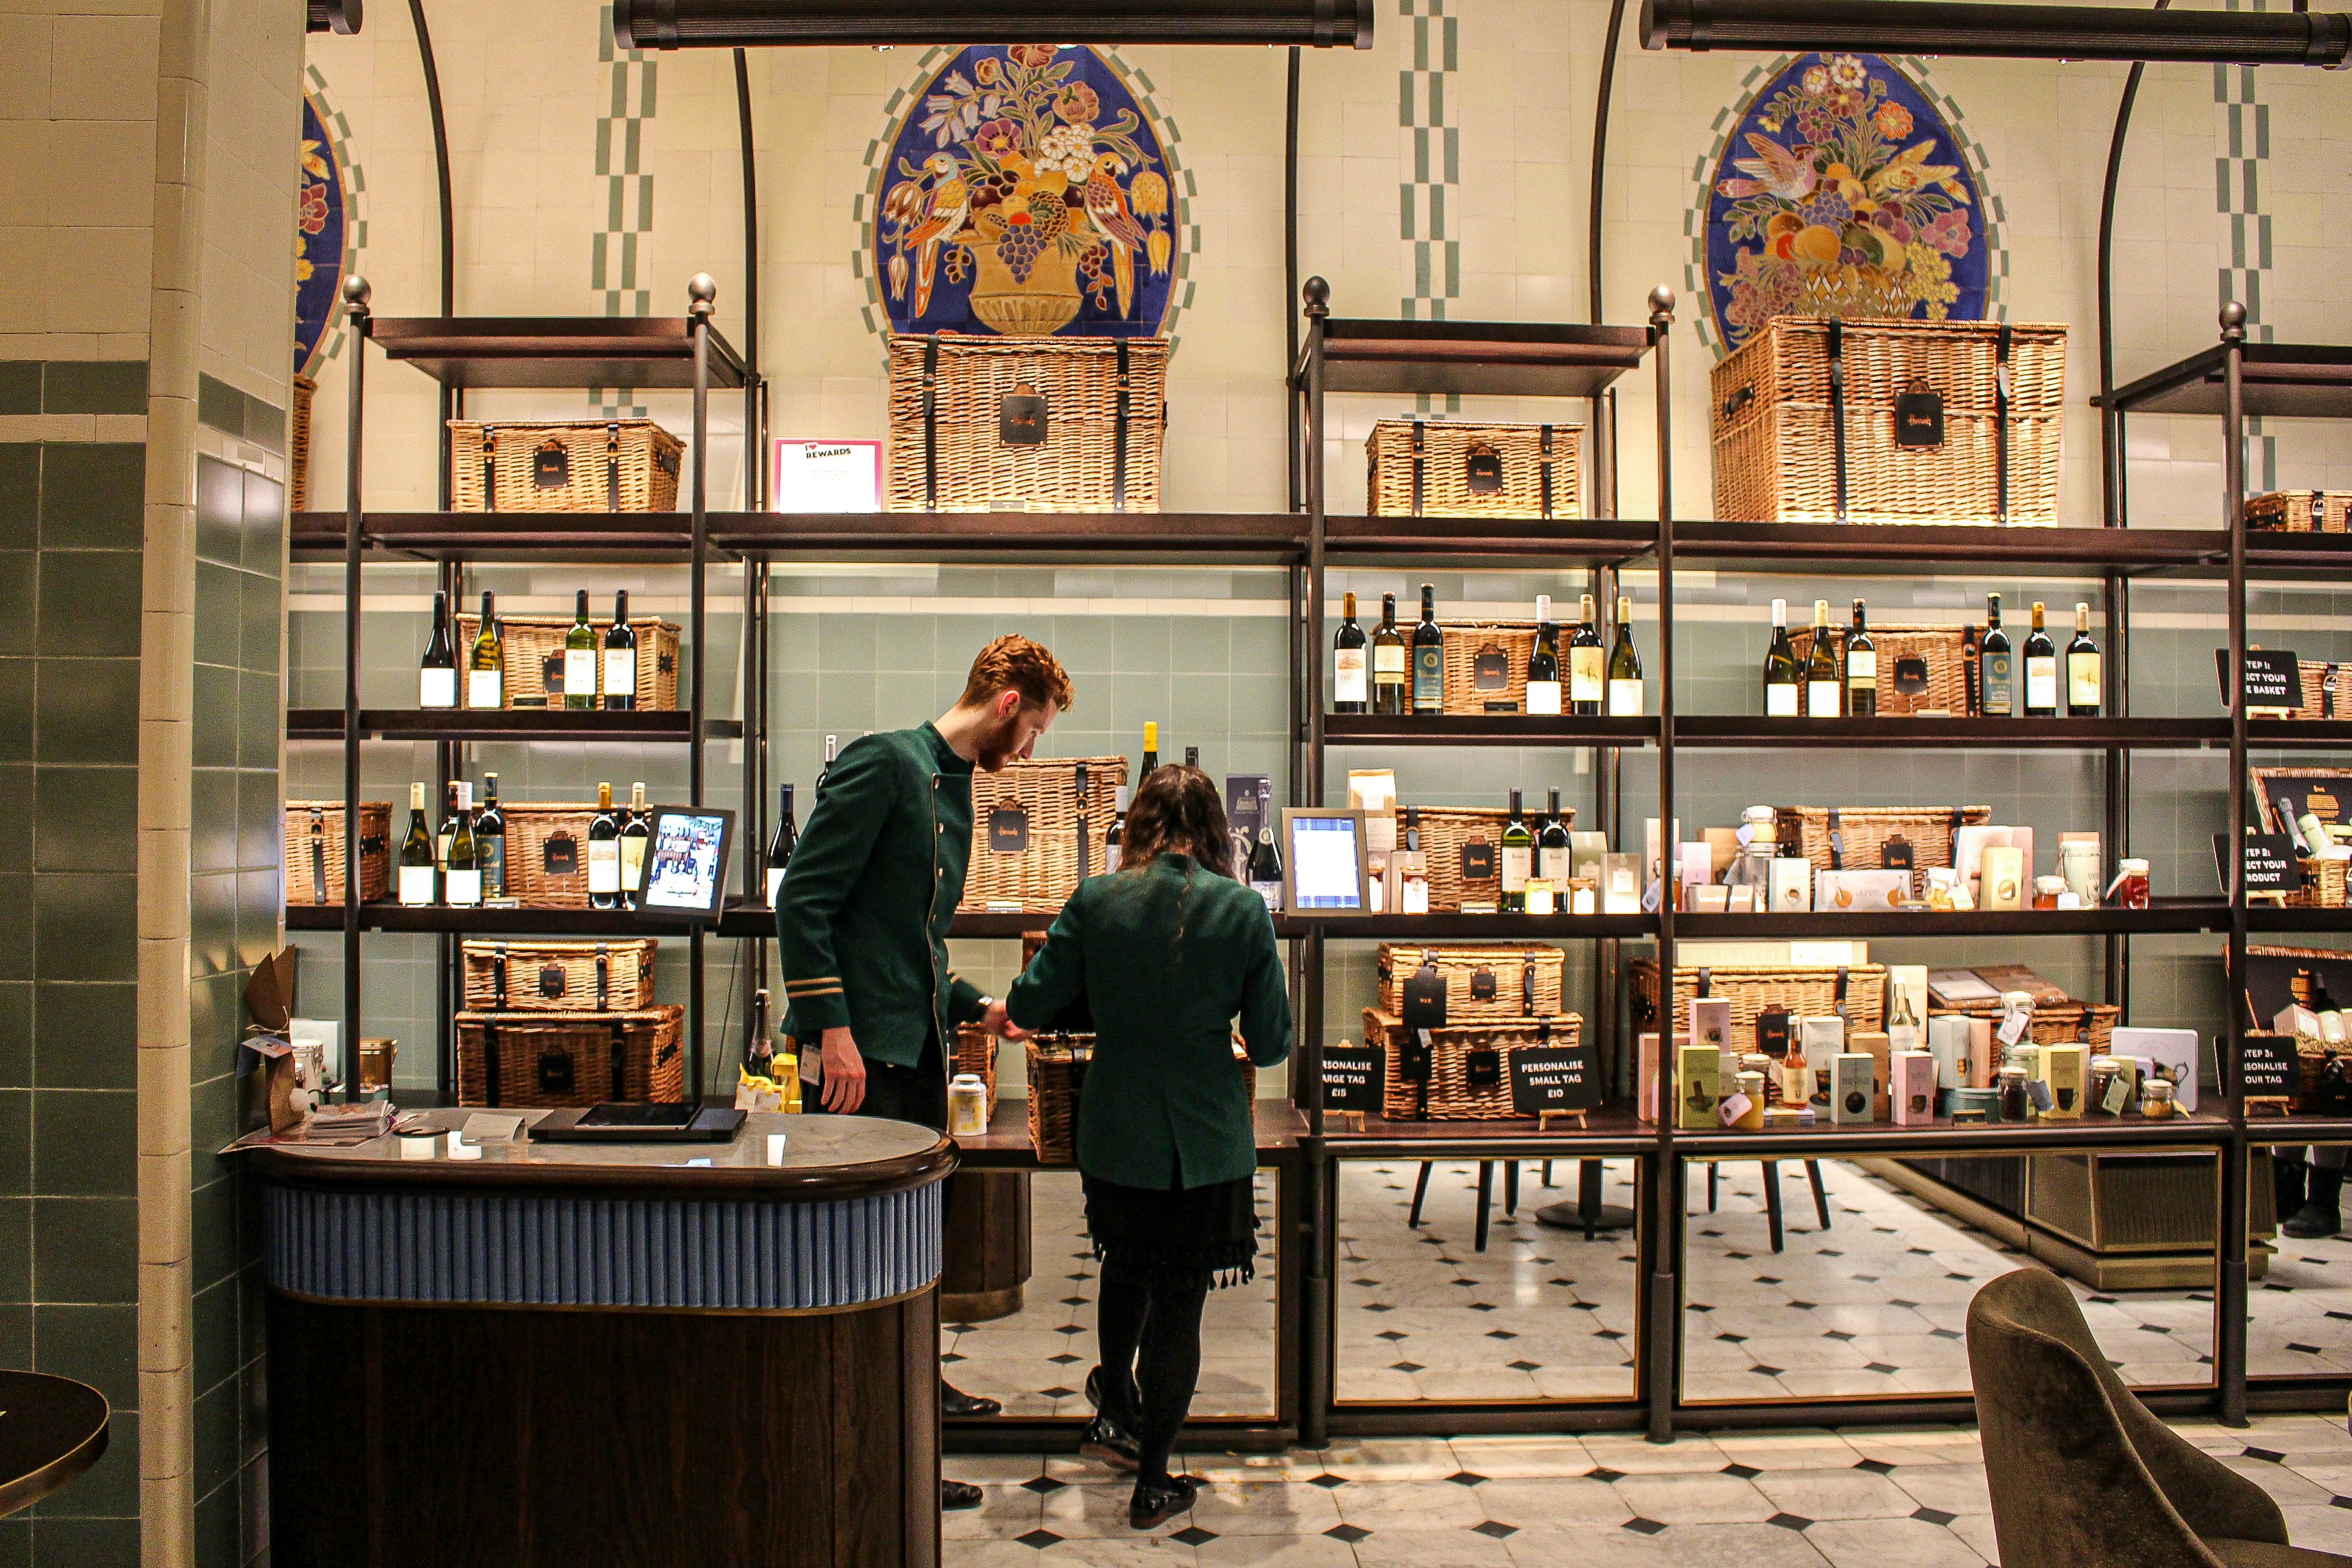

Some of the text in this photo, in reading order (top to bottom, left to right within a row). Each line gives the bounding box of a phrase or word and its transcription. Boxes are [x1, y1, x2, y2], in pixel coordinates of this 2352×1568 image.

[806, 447, 851, 458] REWARDS
[2246, 661, 2262, 669] TEP
[2246, 673, 2287, 682] ECT YOUR
[2253, 685, 2286, 695] BASKET
[2246, 848, 2260, 857] TEP
[2246, 860, 2287, 869] ECT YOUR
[2246, 872, 2281, 882] RODUCT
[1322, 1060, 1371, 1071] RSONALISE
[1521, 1060, 1584, 1073] PERSONALISE
[1322, 1074, 1365, 1084] ARGE TAG
[1530, 1074, 1582, 1086] SMALL TAG
[2246, 1076, 2282, 1084] OUR TAG
[1547, 1089, 1564, 1097] £10
